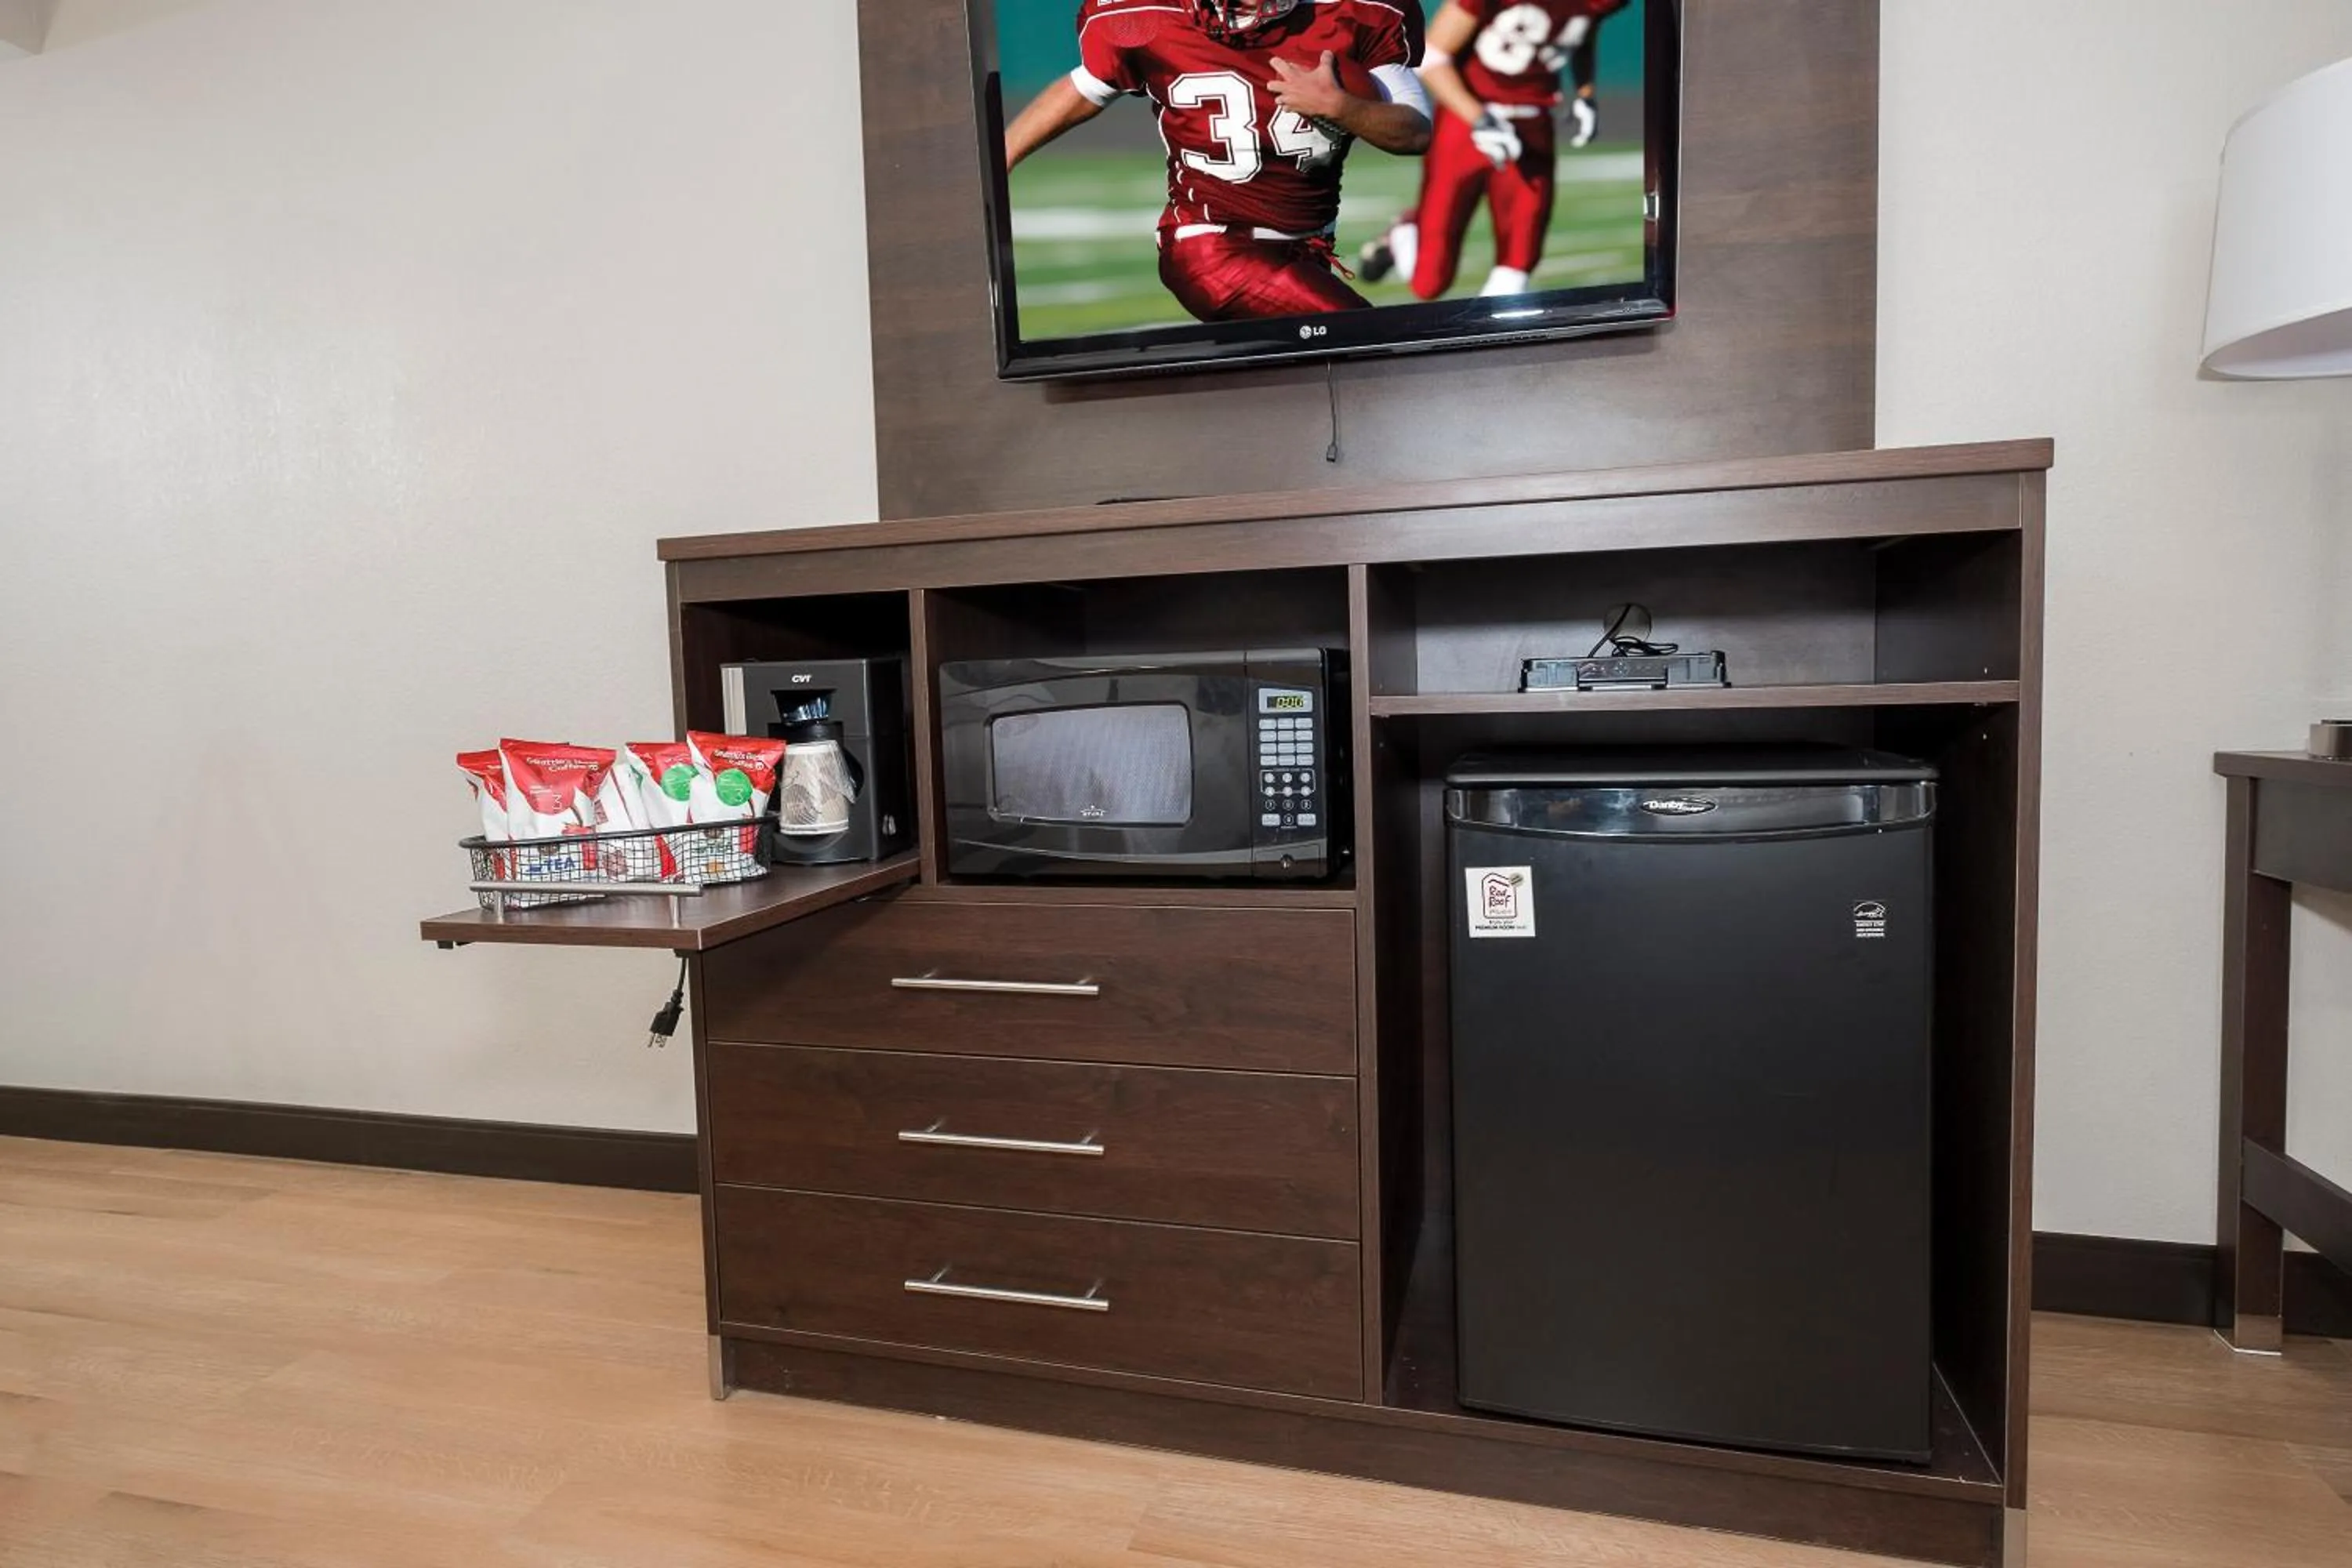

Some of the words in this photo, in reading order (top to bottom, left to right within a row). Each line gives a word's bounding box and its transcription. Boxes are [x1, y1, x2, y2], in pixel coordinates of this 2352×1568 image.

[1167, 70, 1339, 183] 34
[791, 674, 812, 683] CVT
[1648, 800, 1684, 810] Danby
[1489, 886, 1508, 897] Red
[1489, 895, 1512, 908] Roof
